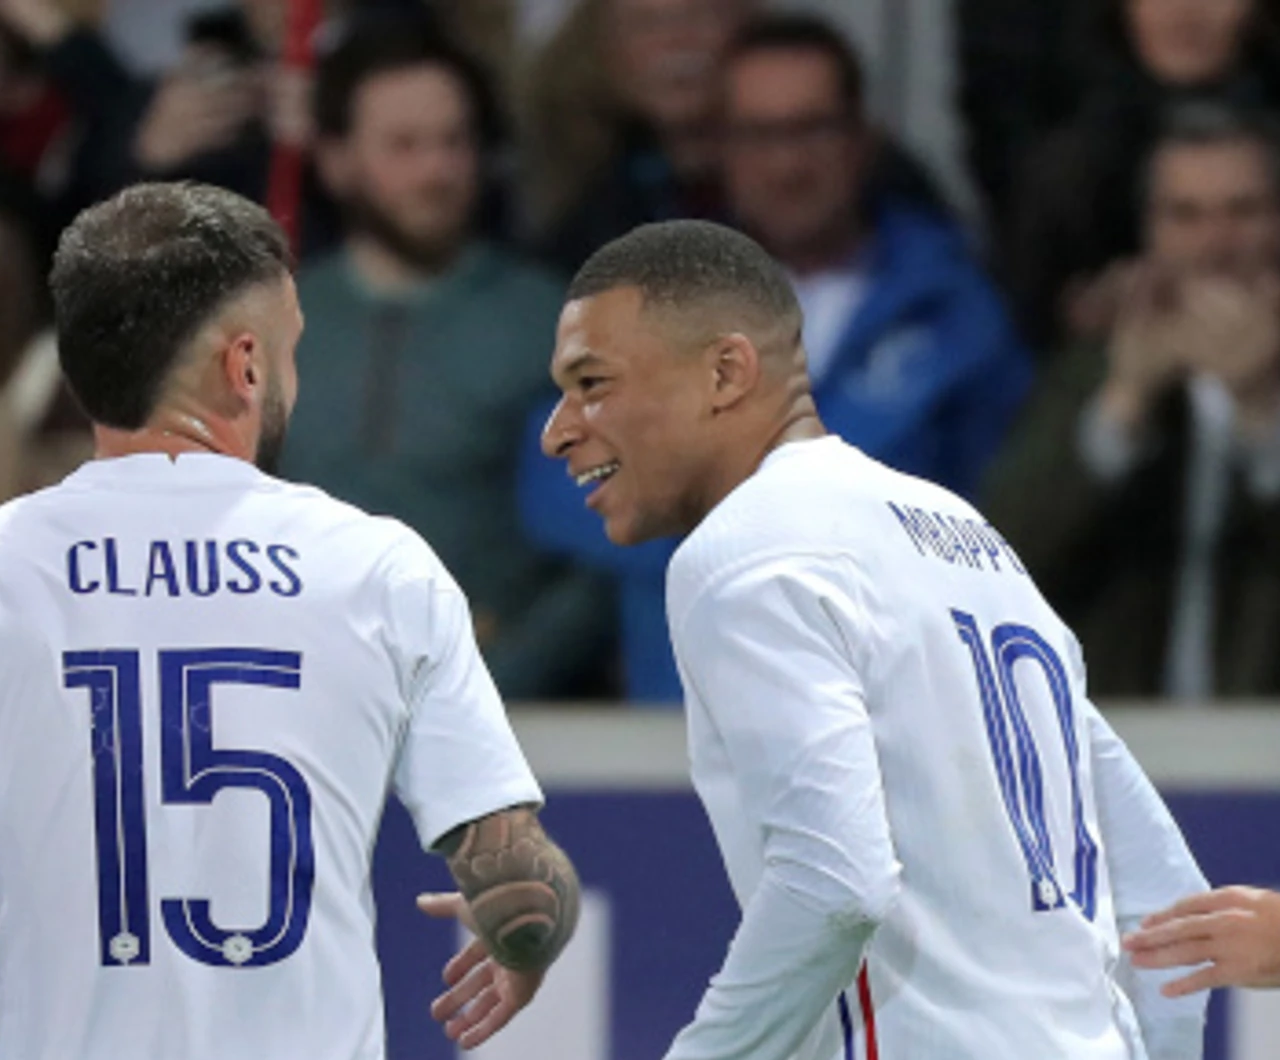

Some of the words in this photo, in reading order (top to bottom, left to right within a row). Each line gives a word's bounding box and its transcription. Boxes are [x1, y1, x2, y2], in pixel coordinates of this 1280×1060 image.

[66, 537, 303, 597] CLAUSS
[886, 500, 1026, 576] MBAPP
[62, 647, 315, 968] 15
[949, 607, 1098, 922] 10
